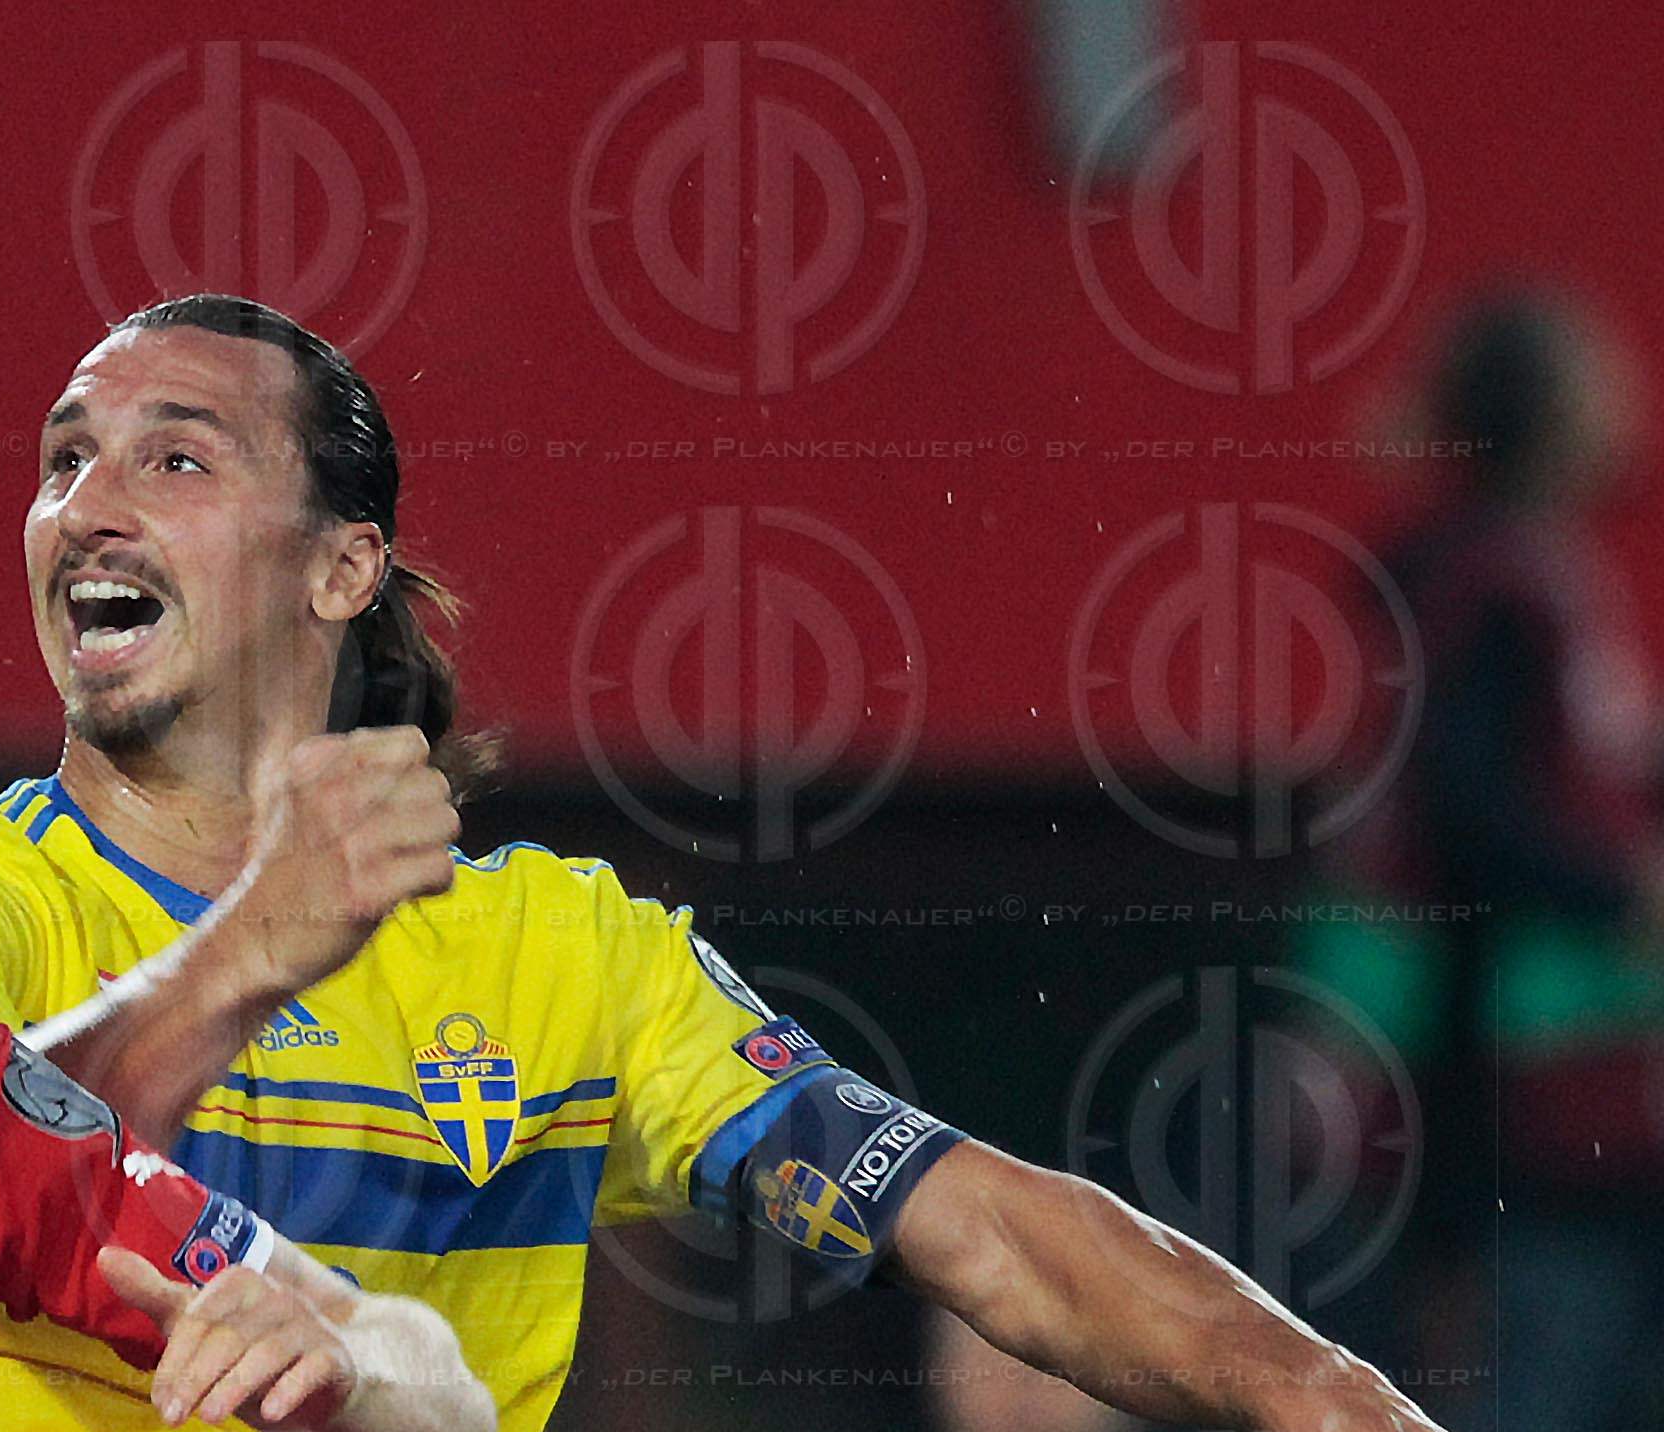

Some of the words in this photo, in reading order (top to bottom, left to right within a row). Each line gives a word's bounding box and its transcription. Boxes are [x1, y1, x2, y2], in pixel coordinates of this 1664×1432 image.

[258, 1025, 340, 1052] adidas
[847, 1150, 890, 1197] NO
[877, 1124, 916, 1151] TO
